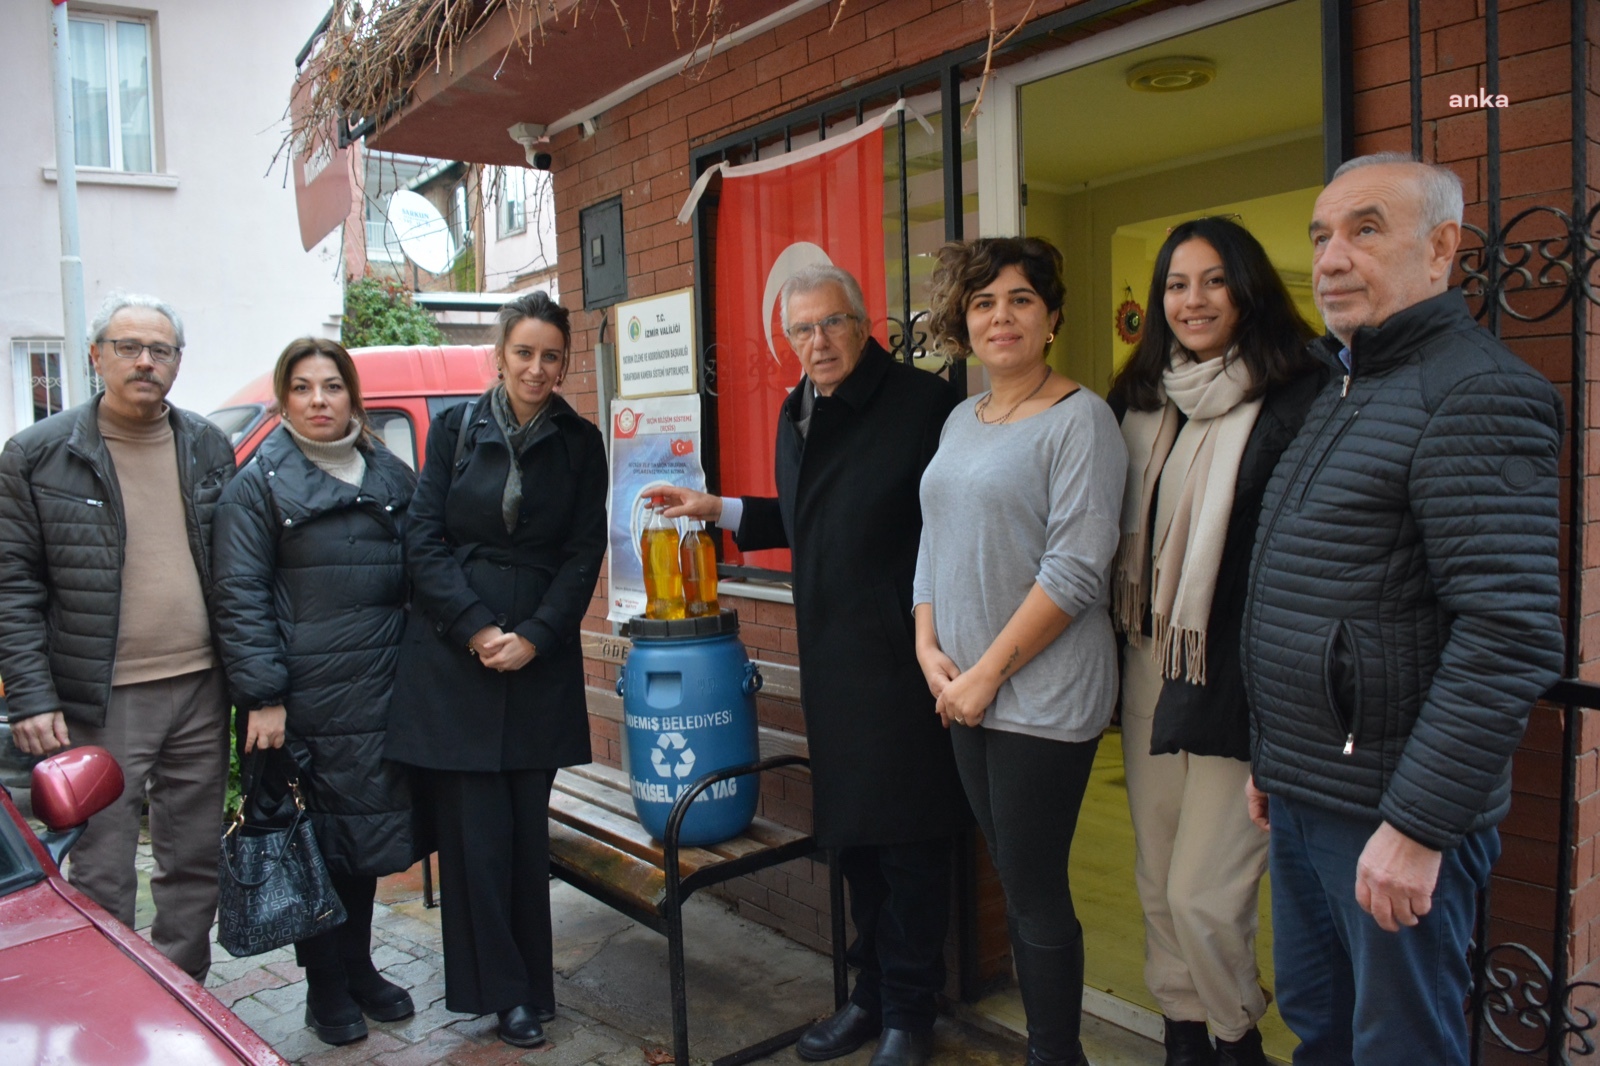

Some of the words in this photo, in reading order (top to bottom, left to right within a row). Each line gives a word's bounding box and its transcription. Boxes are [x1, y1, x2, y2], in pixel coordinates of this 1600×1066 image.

[656, 313, 665, 322] T.C.
[645, 327, 659, 338] İZMİR
[660, 322, 680, 336] VALİLİĞİ
[675, 784, 709, 803] AK
